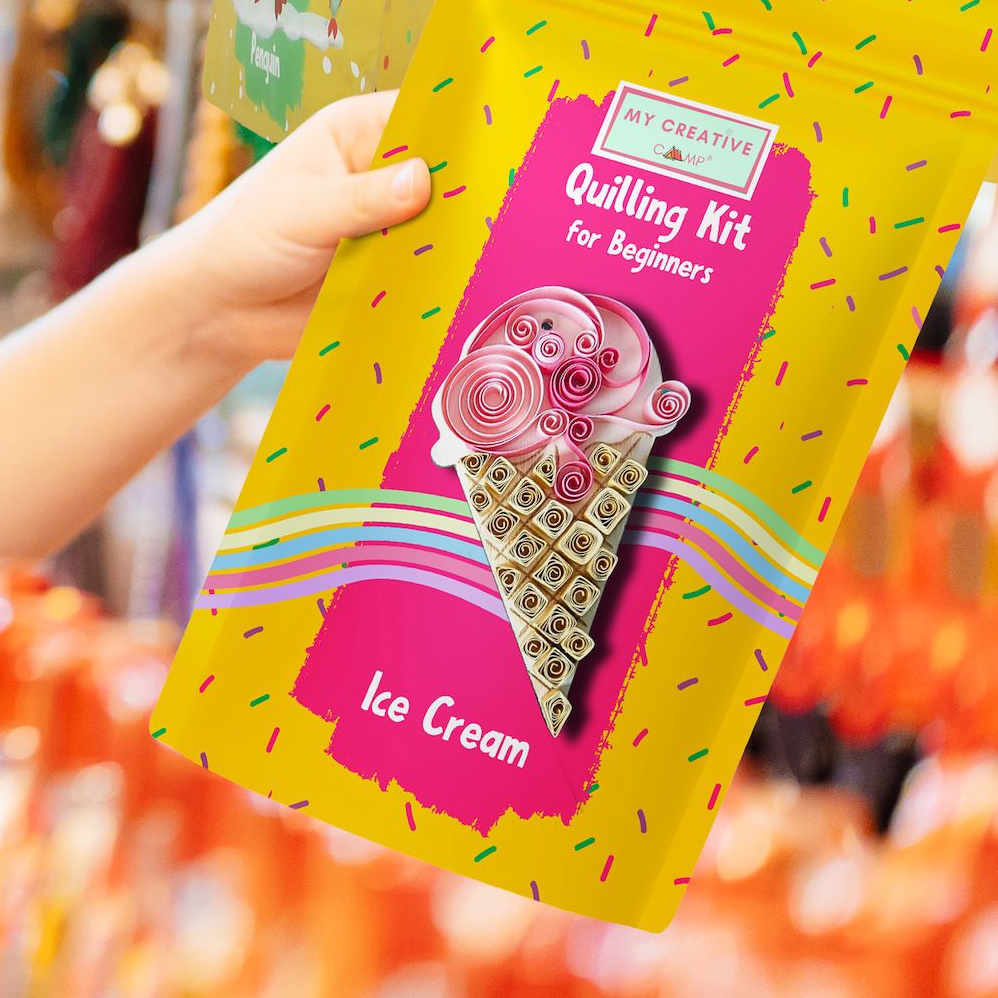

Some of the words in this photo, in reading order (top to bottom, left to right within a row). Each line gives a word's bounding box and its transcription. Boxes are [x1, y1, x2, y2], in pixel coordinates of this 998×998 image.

[250, 29, 280, 85] Penguin
[623, 108, 656, 128] MY
[661, 118, 754, 156] CREATIVE
[565, 162, 689, 243] Quilling
[695, 200, 753, 251] Kit
[565, 219, 602, 249] for
[606, 228, 715, 285] Beginners
[360, 669, 410, 723] Ice
[422, 695, 531, 769] Cream
